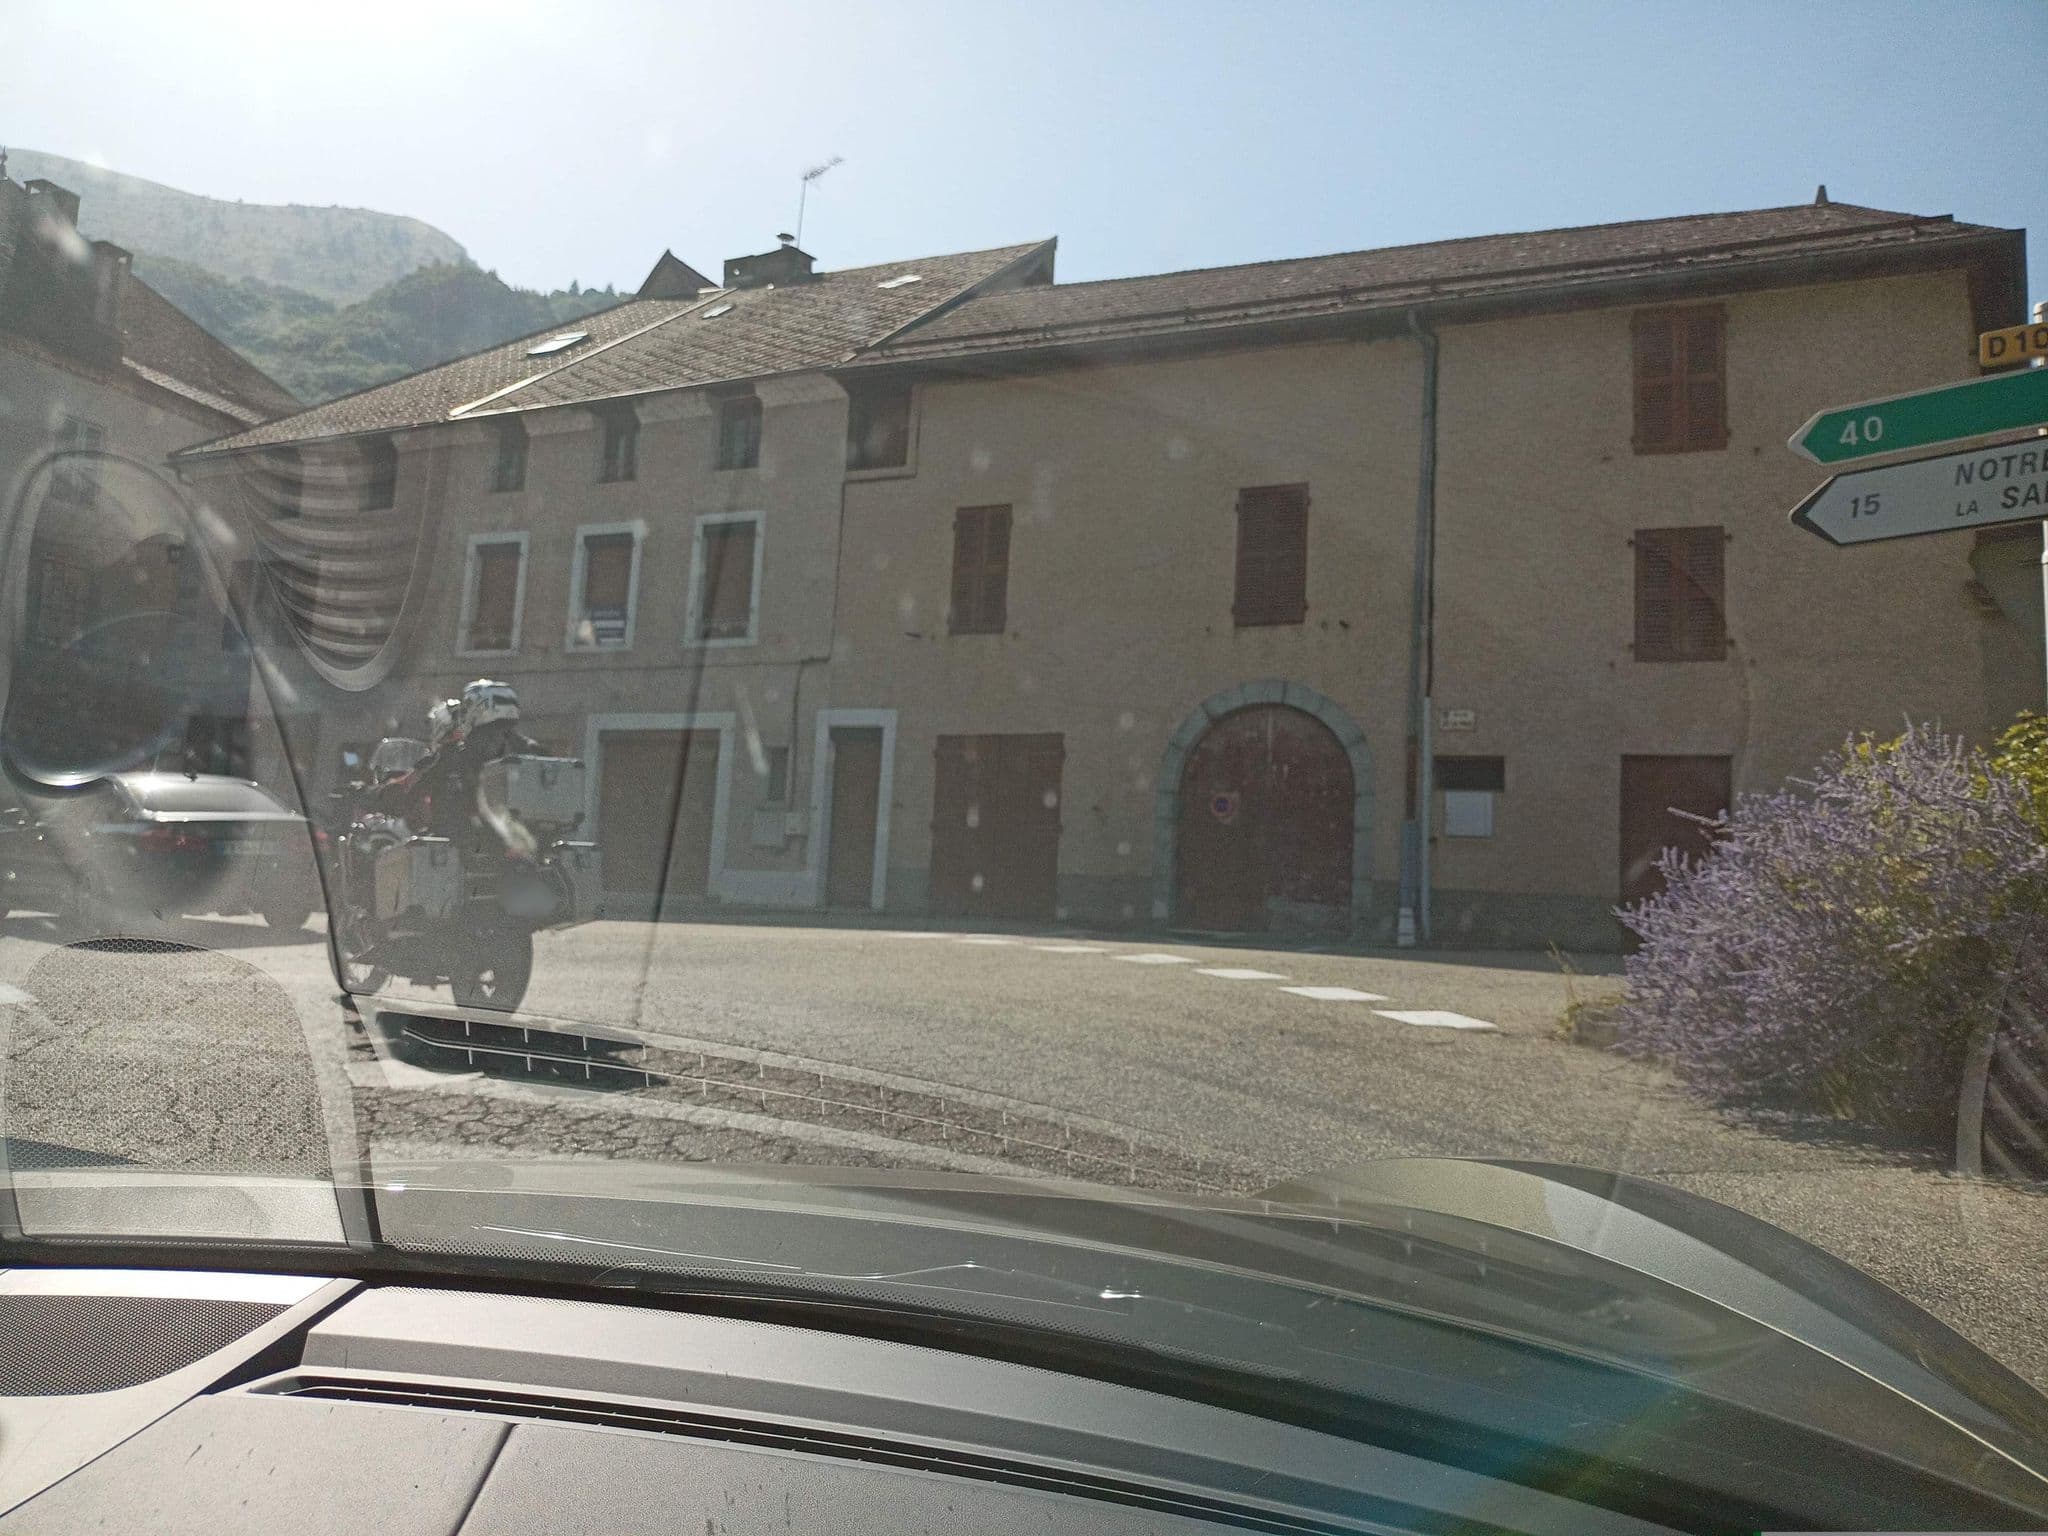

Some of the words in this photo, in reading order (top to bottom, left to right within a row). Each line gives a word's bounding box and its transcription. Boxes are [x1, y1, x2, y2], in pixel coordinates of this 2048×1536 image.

[1839, 416, 1883, 445] 40
[1851, 493, 1880, 518] 15
[1956, 500, 1978, 517] LA
[2001, 482, 2048, 509] SA
